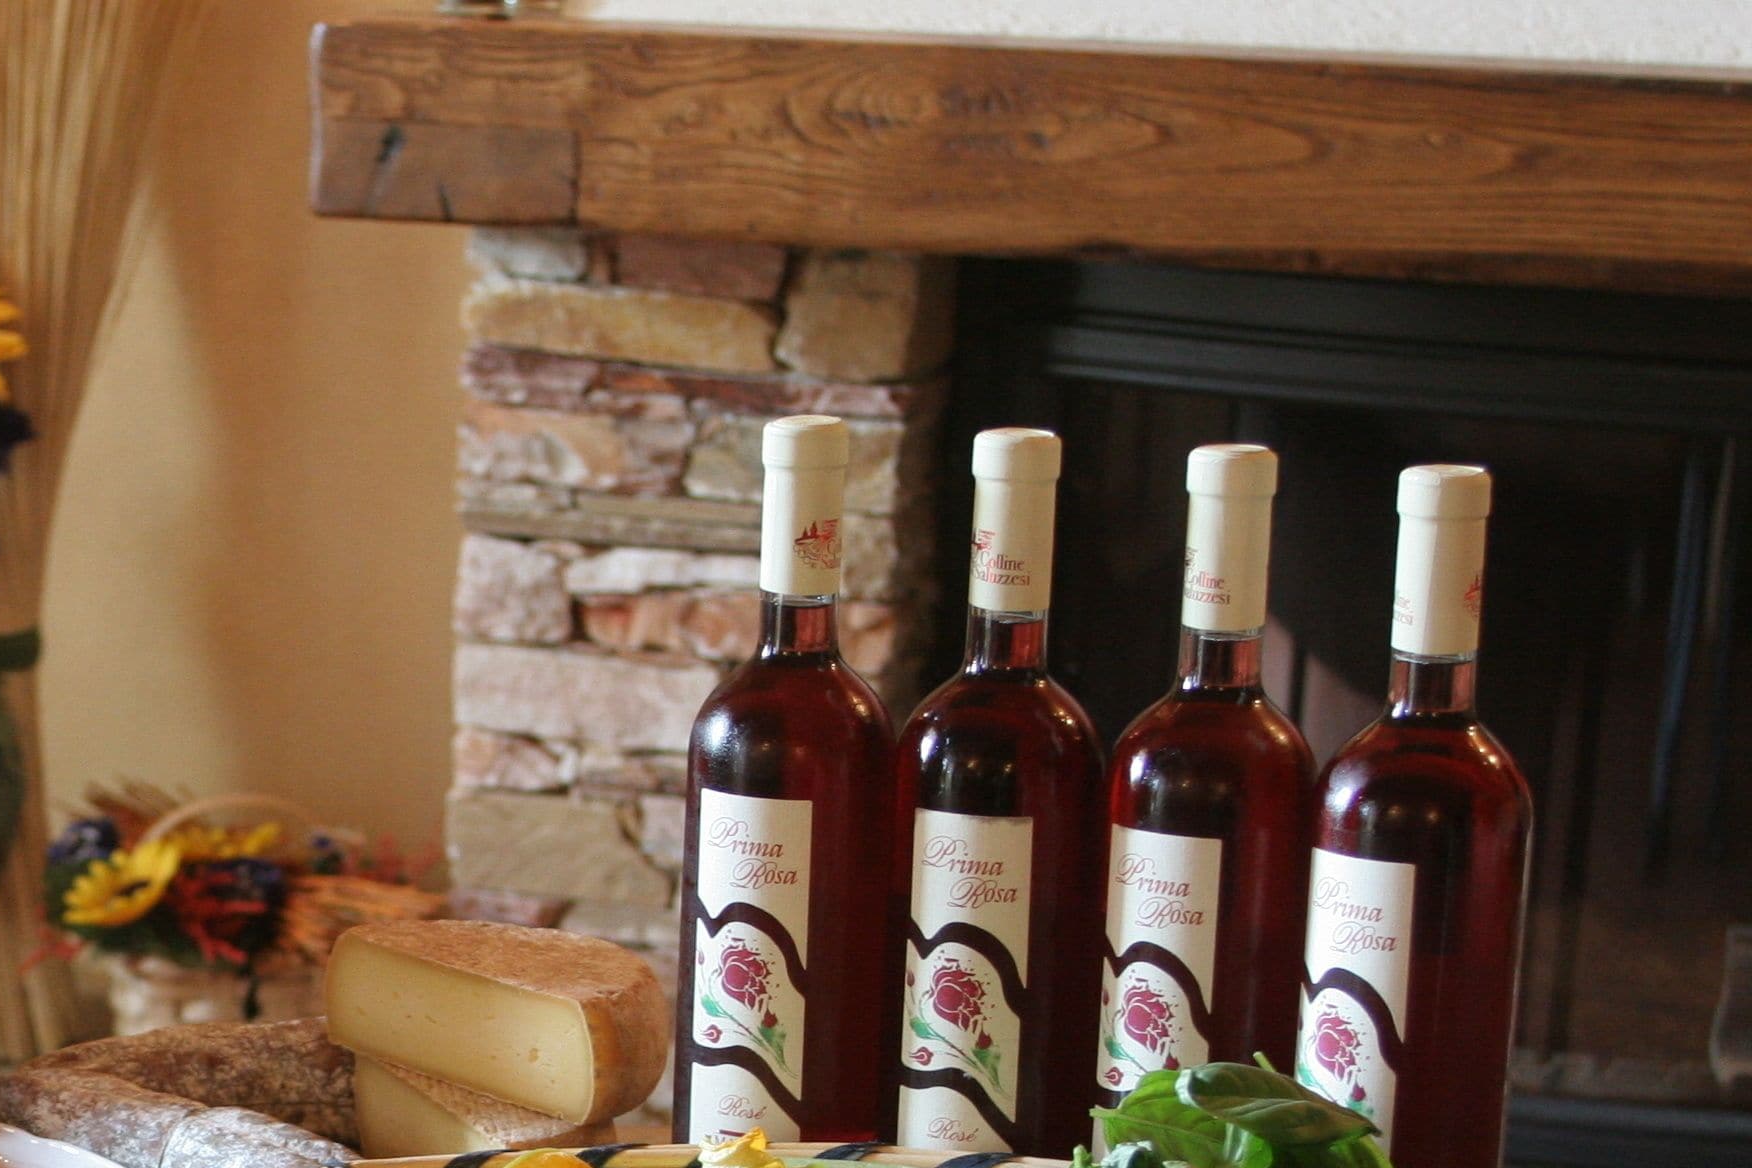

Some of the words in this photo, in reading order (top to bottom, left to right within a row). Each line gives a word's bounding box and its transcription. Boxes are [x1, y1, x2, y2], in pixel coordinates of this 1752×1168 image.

[980, 551, 1025, 571] Colline
[707, 816, 784, 858] Prima
[921, 835, 1004, 876] Prima
[729, 857, 799, 890] Rosa
[1115, 852, 1192, 898] Prima
[946, 876, 1018, 909] Rosa
[1312, 876, 1384, 922] Prima
[1135, 896, 1205, 929] Rosa
[1328, 920, 1397, 955] Rosa
[717, 1094, 768, 1120] Rosé
[926, 1116, 979, 1142] Rosé
